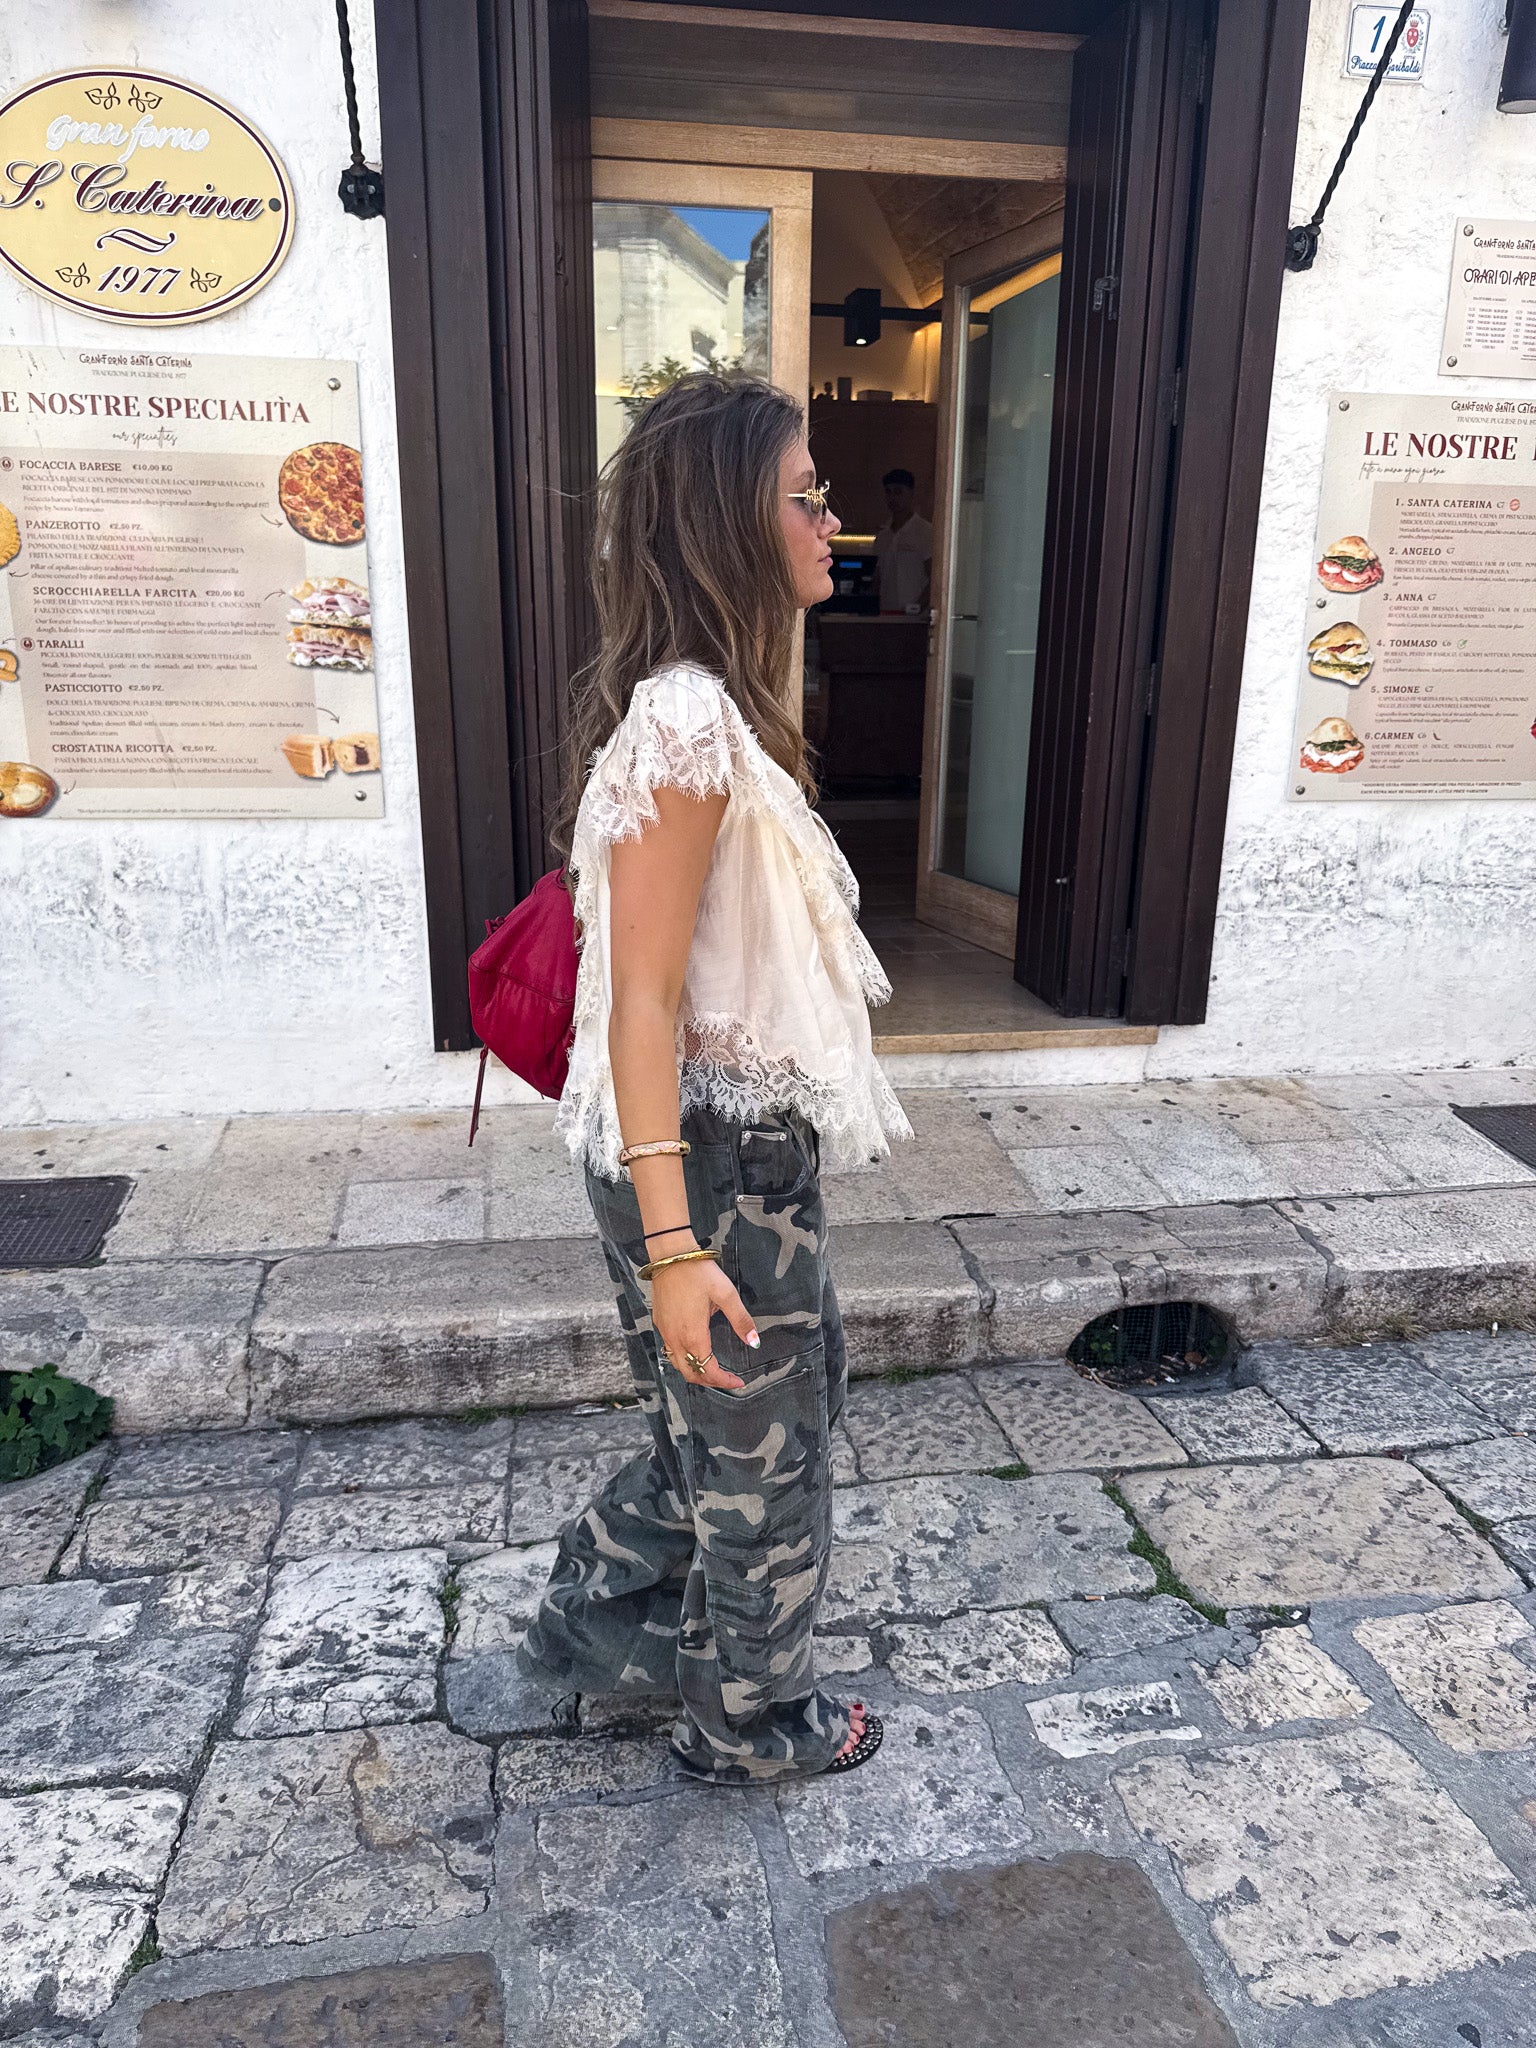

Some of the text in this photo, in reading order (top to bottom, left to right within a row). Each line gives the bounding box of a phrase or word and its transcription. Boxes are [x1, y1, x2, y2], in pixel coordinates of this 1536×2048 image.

[1370, 16, 1386, 53] 1
[117, 114, 210, 163] forno
[70, 162, 265, 220] Caterina
[96, 265, 182, 295] 1977
[1499, 270, 1512, 285] DI
[0, 391, 311, 424] E NOSTRE SPECIALITÀ
[1363, 431, 1398, 456] LE
[1405, 432, 1518, 461] NOSTRE
[20, 460, 76, 470] FOCACCIA
[79, 462, 122, 471] BARESE
[1407, 499, 1440, 507] SANTA
[1443, 500, 1492, 509] CATERINA
[25, 520, 100, 530] PANZEROTTO
[1402, 548, 1441, 556] ANGELO
[33, 586, 140, 597] SCROCCHIARELLA
[145, 588, 197, 598] FARCITA
[1396, 593, 1423, 601] ANNA
[37, 639, 84, 649] TARALLI
[1389, 639, 1438, 648] TOMMASO
[45, 684, 122, 692] PASTICCIOTTO
[1383, 685, 1421, 694] SIMONE
[52, 743, 123, 753] CROSTATINA
[126, 744, 174, 753] RICOTTA
